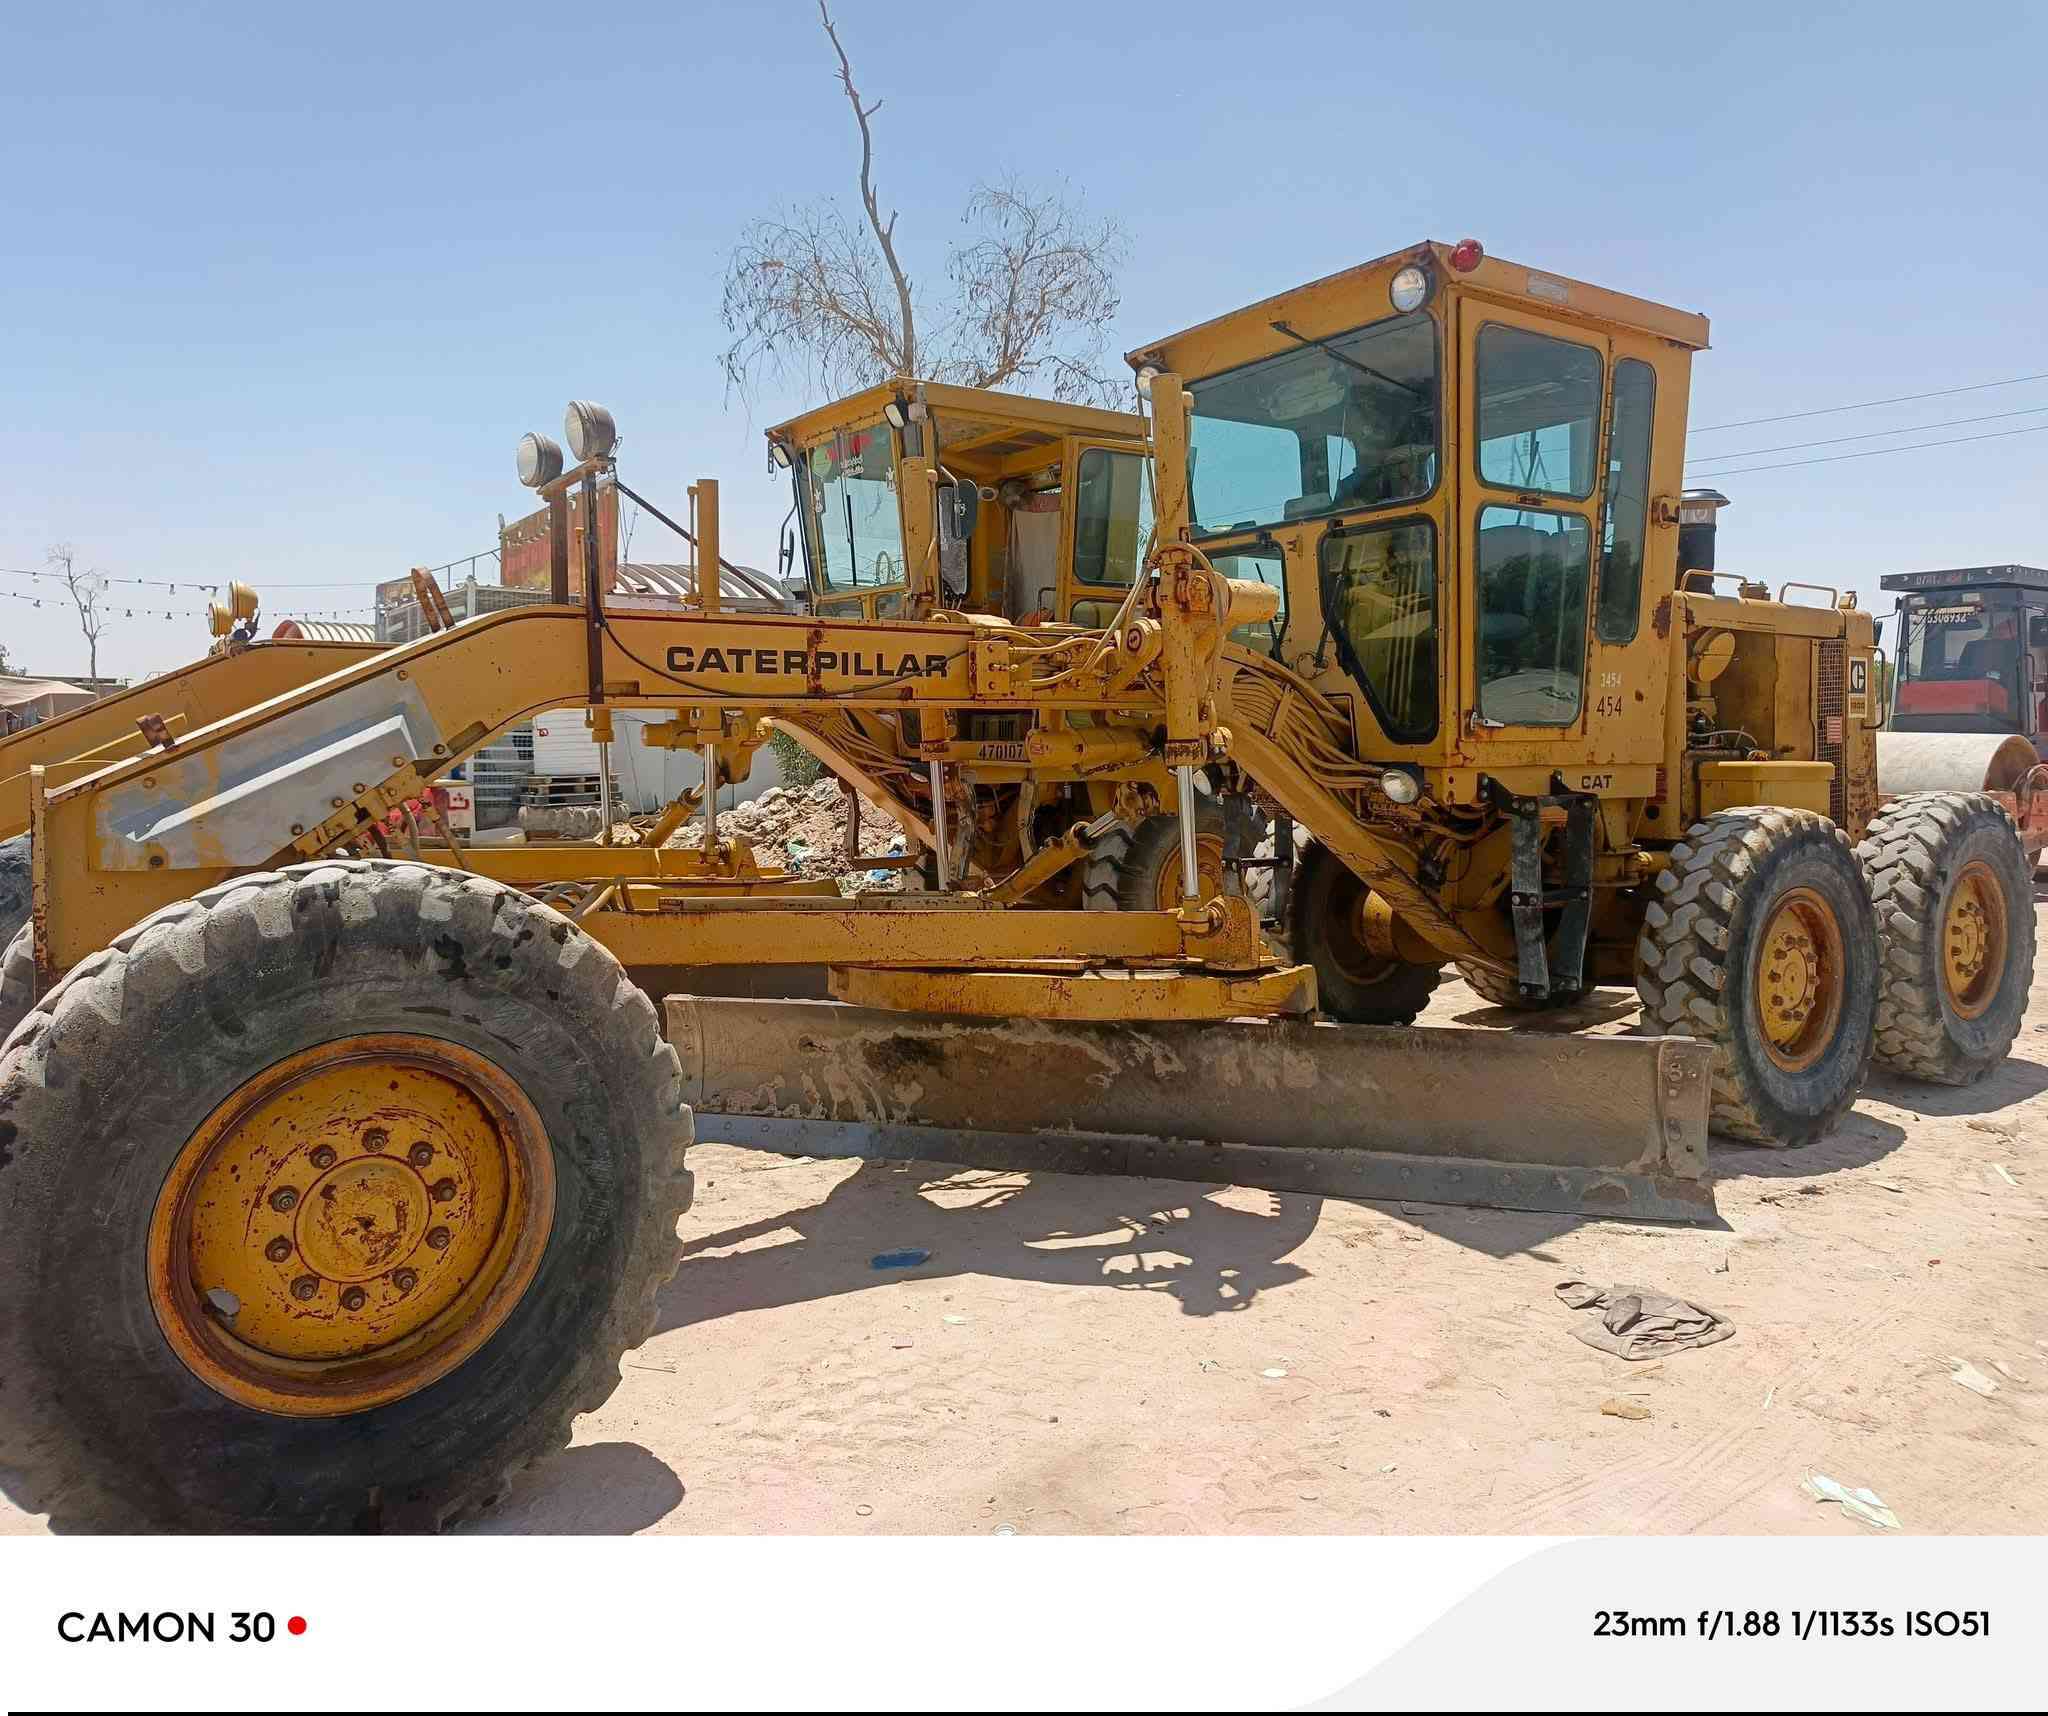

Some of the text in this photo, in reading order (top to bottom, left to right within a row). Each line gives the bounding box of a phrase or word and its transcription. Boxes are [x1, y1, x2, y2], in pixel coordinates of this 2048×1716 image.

[666, 646, 948, 678] CATERPILLAR
[1596, 695, 1622, 718] 454
[979, 743, 1024, 760] 470107
[1581, 775, 1613, 789] CAT
